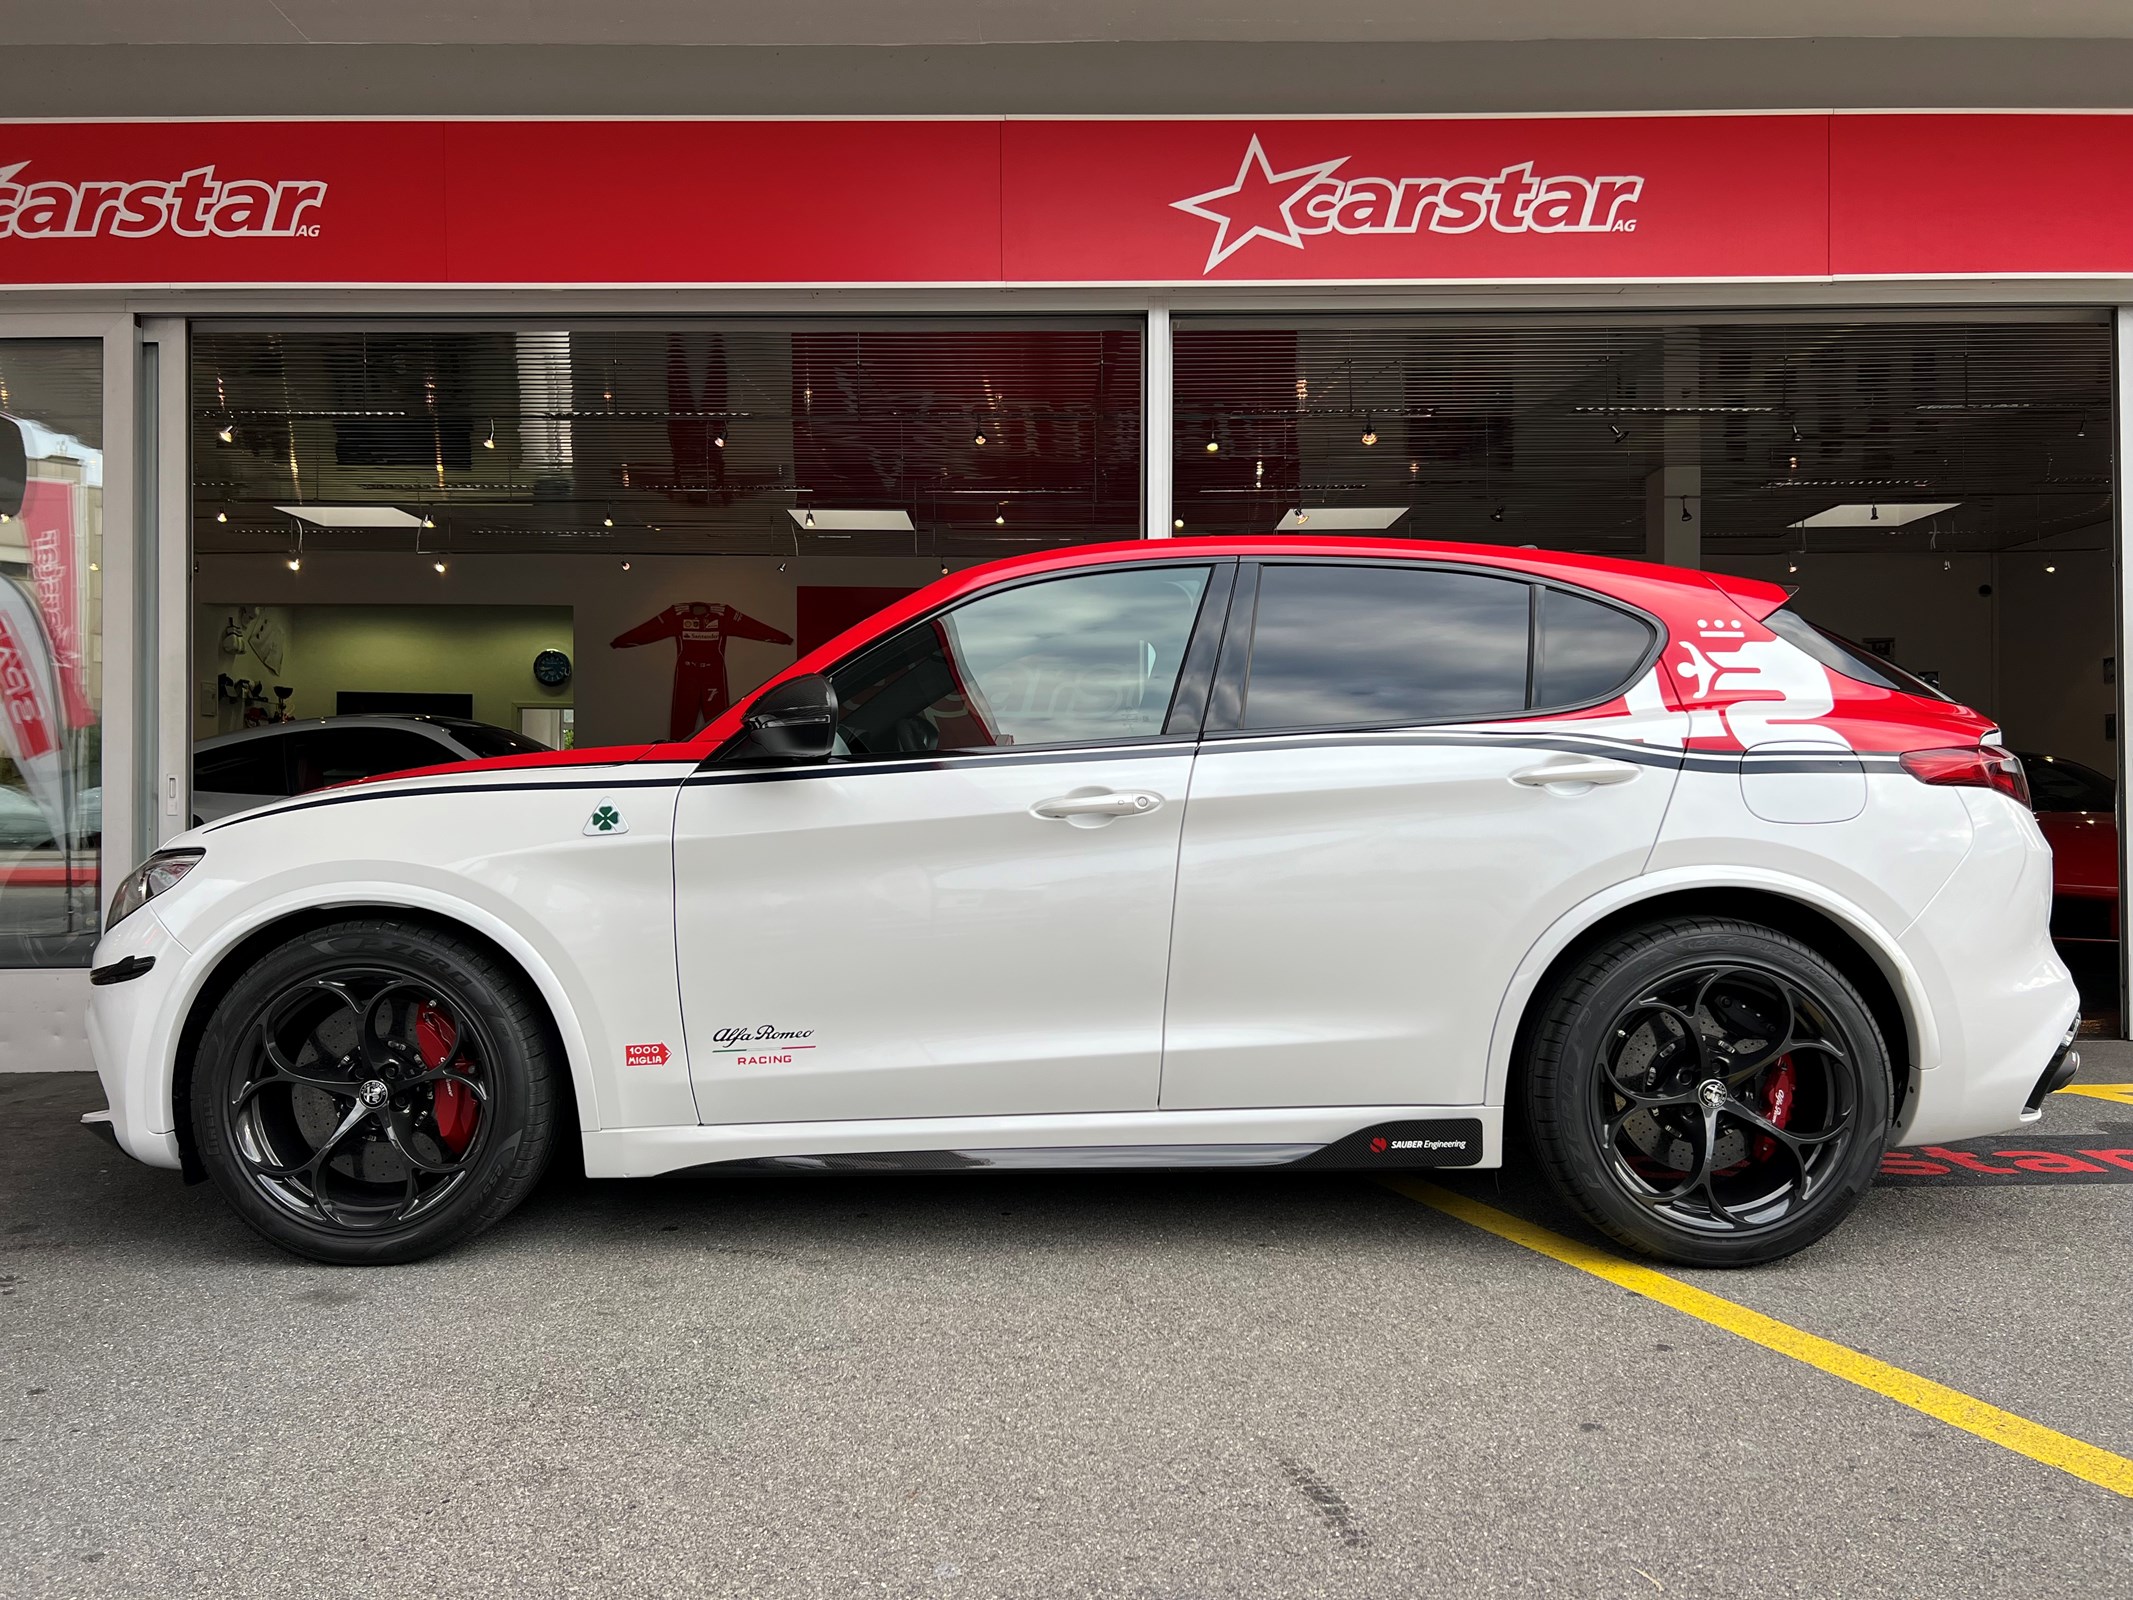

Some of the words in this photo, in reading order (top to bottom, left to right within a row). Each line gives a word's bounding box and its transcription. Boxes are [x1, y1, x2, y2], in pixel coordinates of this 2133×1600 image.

[1299, 161, 1645, 235] carstar
[1612, 219, 1637, 232] AG
[296, 224, 320, 237] AG
[707, 688, 719, 702] 7
[712, 1027, 753, 1048] Alfa
[753, 1024, 815, 1041] Romeo
[629, 1046, 660, 1055] 1000
[627, 1056, 663, 1065] MIGLIA
[737, 1055, 792, 1065] RACING
[1390, 1140, 1423, 1149] SAUBER
[1423, 1139, 1467, 1150] Engineering
